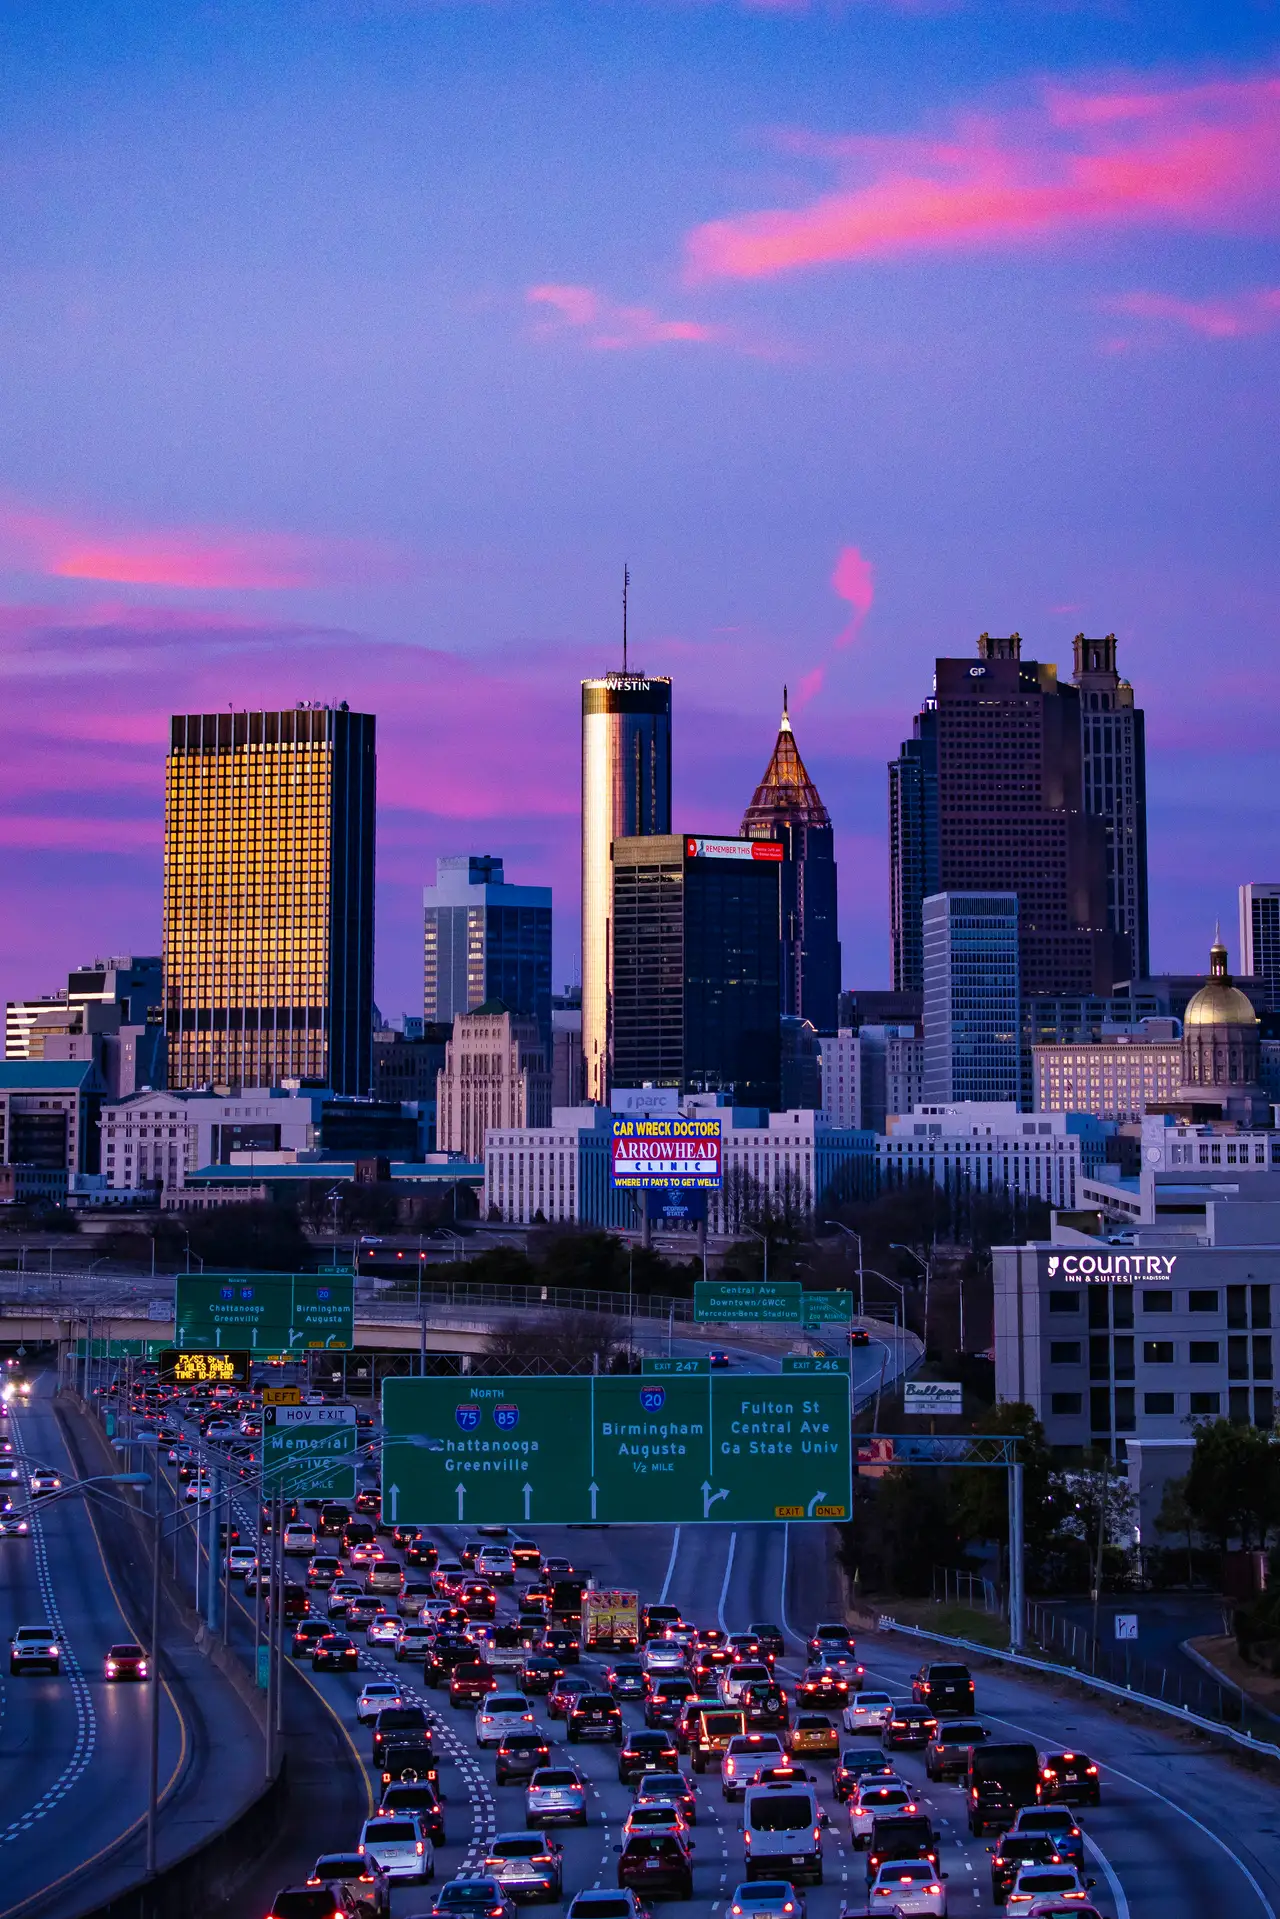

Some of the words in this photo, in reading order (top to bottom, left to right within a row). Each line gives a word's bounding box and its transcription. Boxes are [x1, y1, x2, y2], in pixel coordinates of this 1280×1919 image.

[969, 667, 986, 677] GP
[605, 679, 650, 691] WESTIN
[705, 844, 737, 854] REMEMBER
[737, 846, 751, 855] THIS
[635, 1096, 667, 1109] parc
[613, 1121, 634, 1136] CAR
[635, 1121, 672, 1136] WRECK
[673, 1121, 720, 1136] DOCTORS
[614, 1139, 718, 1159] ARROWHEAD
[635, 1162, 701, 1171] CLINIC
[614, 1178, 641, 1187] WHERE
[642, 1178, 649, 1187] IT
[650, 1178, 669, 1187] PAYS
[670, 1178, 680, 1187] TO
[681, 1178, 696, 1187] GET
[697, 1178, 720, 1187] WELL!
[1062, 1255, 1177, 1274] COUNTRY
[1094, 1275, 1128, 1283] SUITES
[222, 1290, 232, 1298] 75
[242, 1290, 252, 1298] 85
[319, 1290, 329, 1298] 20
[720, 1286, 755, 1294] Central
[759, 1286, 776, 1294] Ave
[710, 1298, 786, 1307] Downtown/GWCC
[209, 1304, 265, 1314] Chattanooga
[296, 1304, 351, 1315] Birmingham
[214, 1315, 259, 1323] Greenville
[305, 1315, 343, 1324] Augusta
[184, 1363, 207, 1371] MILES
[210, 1363, 235, 1371] AHEAD
[654, 1362, 671, 1371] EXIT
[675, 1361, 699, 1372] 247
[793, 1361, 810, 1369] EXIT
[814, 1360, 839, 1371] 246
[175, 1371, 196, 1379] TIME:
[470, 1388, 504, 1398] NORTH
[905, 1383, 962, 1400] Bullpen
[267, 1392, 296, 1402] LEFT
[645, 1393, 662, 1406] 20
[741, 1401, 794, 1414] Fulton
[803, 1401, 820, 1414] St
[287, 1410, 312, 1420] HOV
[318, 1410, 345, 1420] EXIT
[460, 1412, 477, 1425] 75
[498, 1412, 515, 1425] 85
[602, 1422, 704, 1438] Birmingham
[731, 1421, 791, 1434] Central
[800, 1421, 830, 1434] Ave
[271, 1437, 348, 1449] Memorial
[721, 1442, 741, 1454] Ga
[749, 1442, 793, 1454] State
[801, 1441, 839, 1453] Univ
[618, 1443, 687, 1458] Augusta
[445, 1458, 529, 1472] Greenville
[651, 1462, 675, 1472] MILE
[311, 1480, 334, 1489] MILE
[778, 1507, 801, 1516] EXIT
[818, 1506, 844, 1515] ONLY
